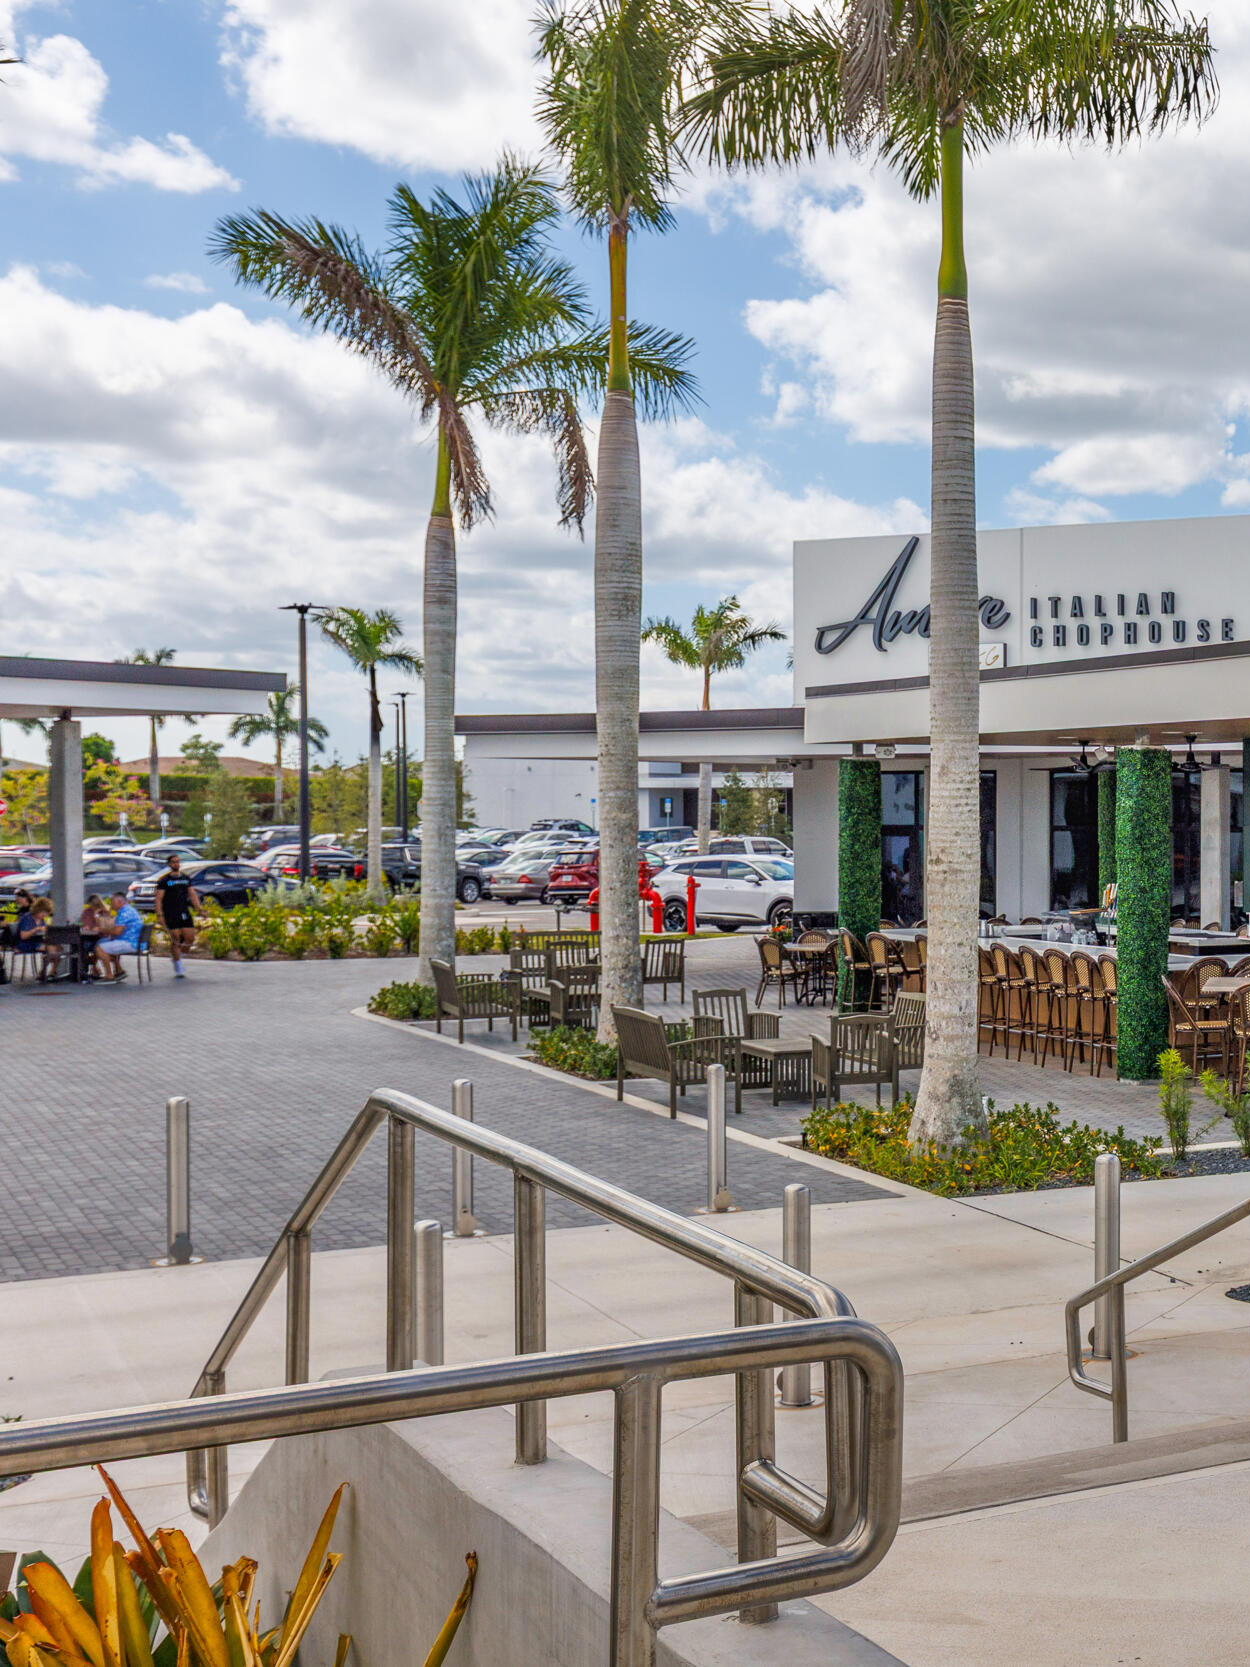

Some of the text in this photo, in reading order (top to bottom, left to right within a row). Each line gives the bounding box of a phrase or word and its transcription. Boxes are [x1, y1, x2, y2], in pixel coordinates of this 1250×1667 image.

[814, 536, 1010, 654] Ame
[1030, 591, 1176, 620] ITALIAN
[1030, 618, 1234, 648] CHOPHOUSE
